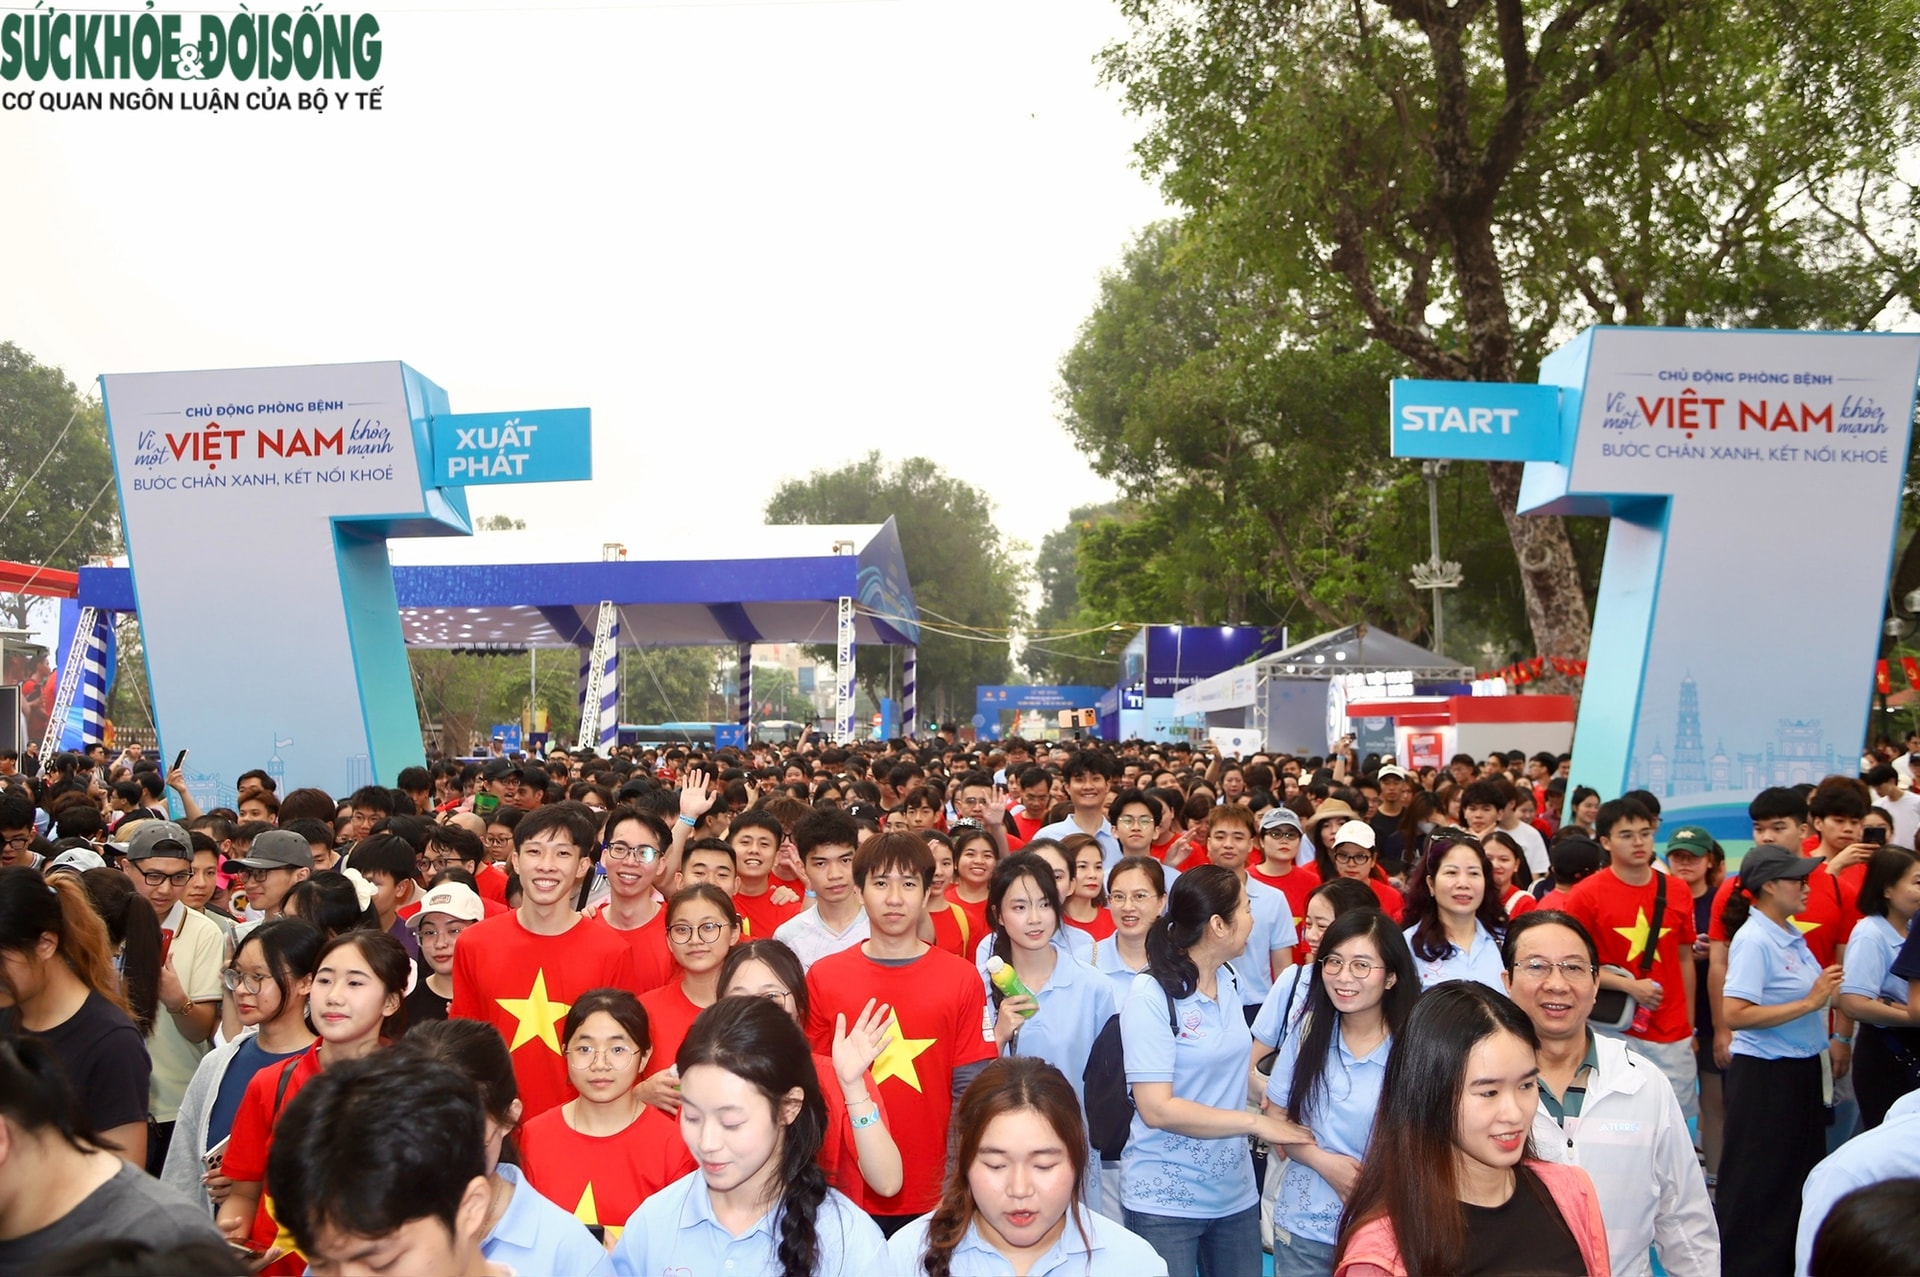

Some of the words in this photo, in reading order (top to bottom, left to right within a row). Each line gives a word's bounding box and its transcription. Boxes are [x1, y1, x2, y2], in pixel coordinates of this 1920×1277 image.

[1692, 369, 1734, 385] ĐỘNG
[1738, 370, 1789, 384] PHÒNG
[1793, 371, 1833, 386] BỆNH
[185, 403, 213, 417] CHỦ
[216, 403, 254, 418] ĐỘNG
[258, 401, 304, 414] PHÒNG
[308, 399, 343, 413] BỆNH
[1402, 405, 1519, 434] START
[1636, 387, 1725, 439] VIỆT
[1738, 400, 1833, 433] NAM
[456, 418, 538, 450] XUẤT
[1603, 409, 1641, 435] một
[1837, 420, 1888, 438] mạnh
[134, 446, 169, 470] một
[165, 421, 245, 470] VIỆT
[257, 426, 343, 458] NAM
[347, 440, 394, 459] mạnh
[1602, 441, 1650, 458] BƯỚC
[1655, 442, 1705, 459] CHÂN
[1768, 444, 1799, 461] KẾT
[1804, 445, 1836, 462] NỐI
[448, 448, 530, 478] PHÁT
[133, 474, 177, 491] BƯỚC
[181, 473, 227, 489] CHÂN
[231, 473, 280, 487] XANH,
[284, 467, 312, 485] KẾT
[316, 466, 345, 483] NỐI
